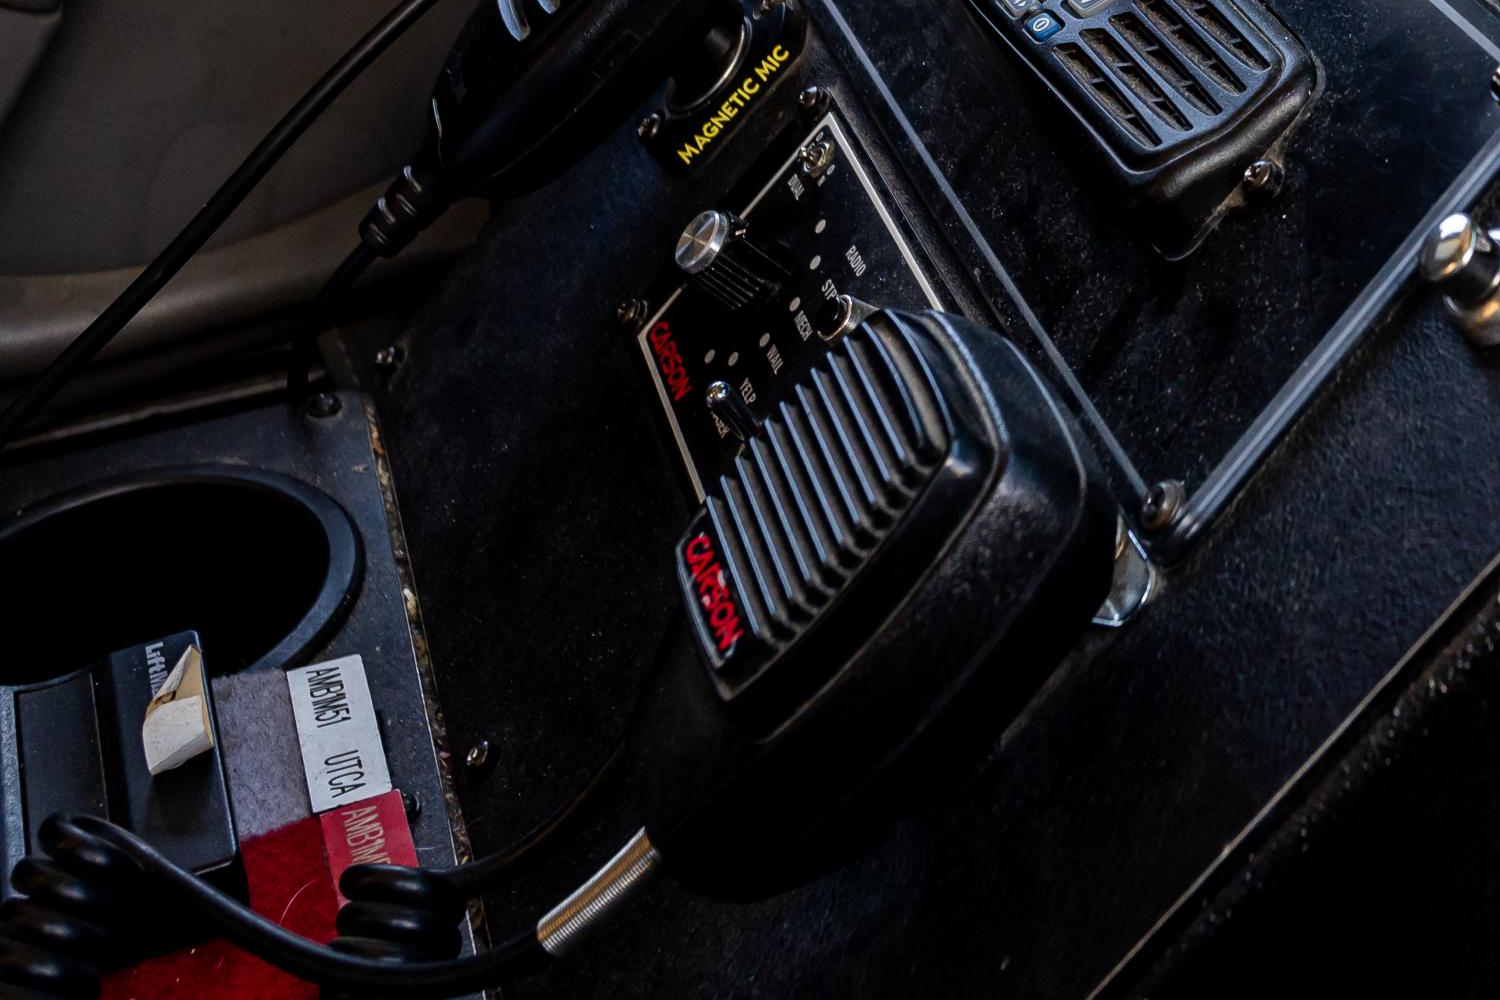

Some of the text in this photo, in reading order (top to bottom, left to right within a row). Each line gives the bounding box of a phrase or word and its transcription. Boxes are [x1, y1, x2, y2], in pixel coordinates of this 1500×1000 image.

[677, 44, 790, 165] MAGNETIC MIC
[845, 245, 867, 277] RADIO
[793, 310, 813, 341] MECH
[650, 321, 693, 401] CARSON
[766, 343, 784, 375] WAIL
[739, 377, 756, 405] YELP
[686, 534, 745, 651] CARSON
[324, 750, 366, 799] UTCA
[341, 805, 392, 866] AMB1M
